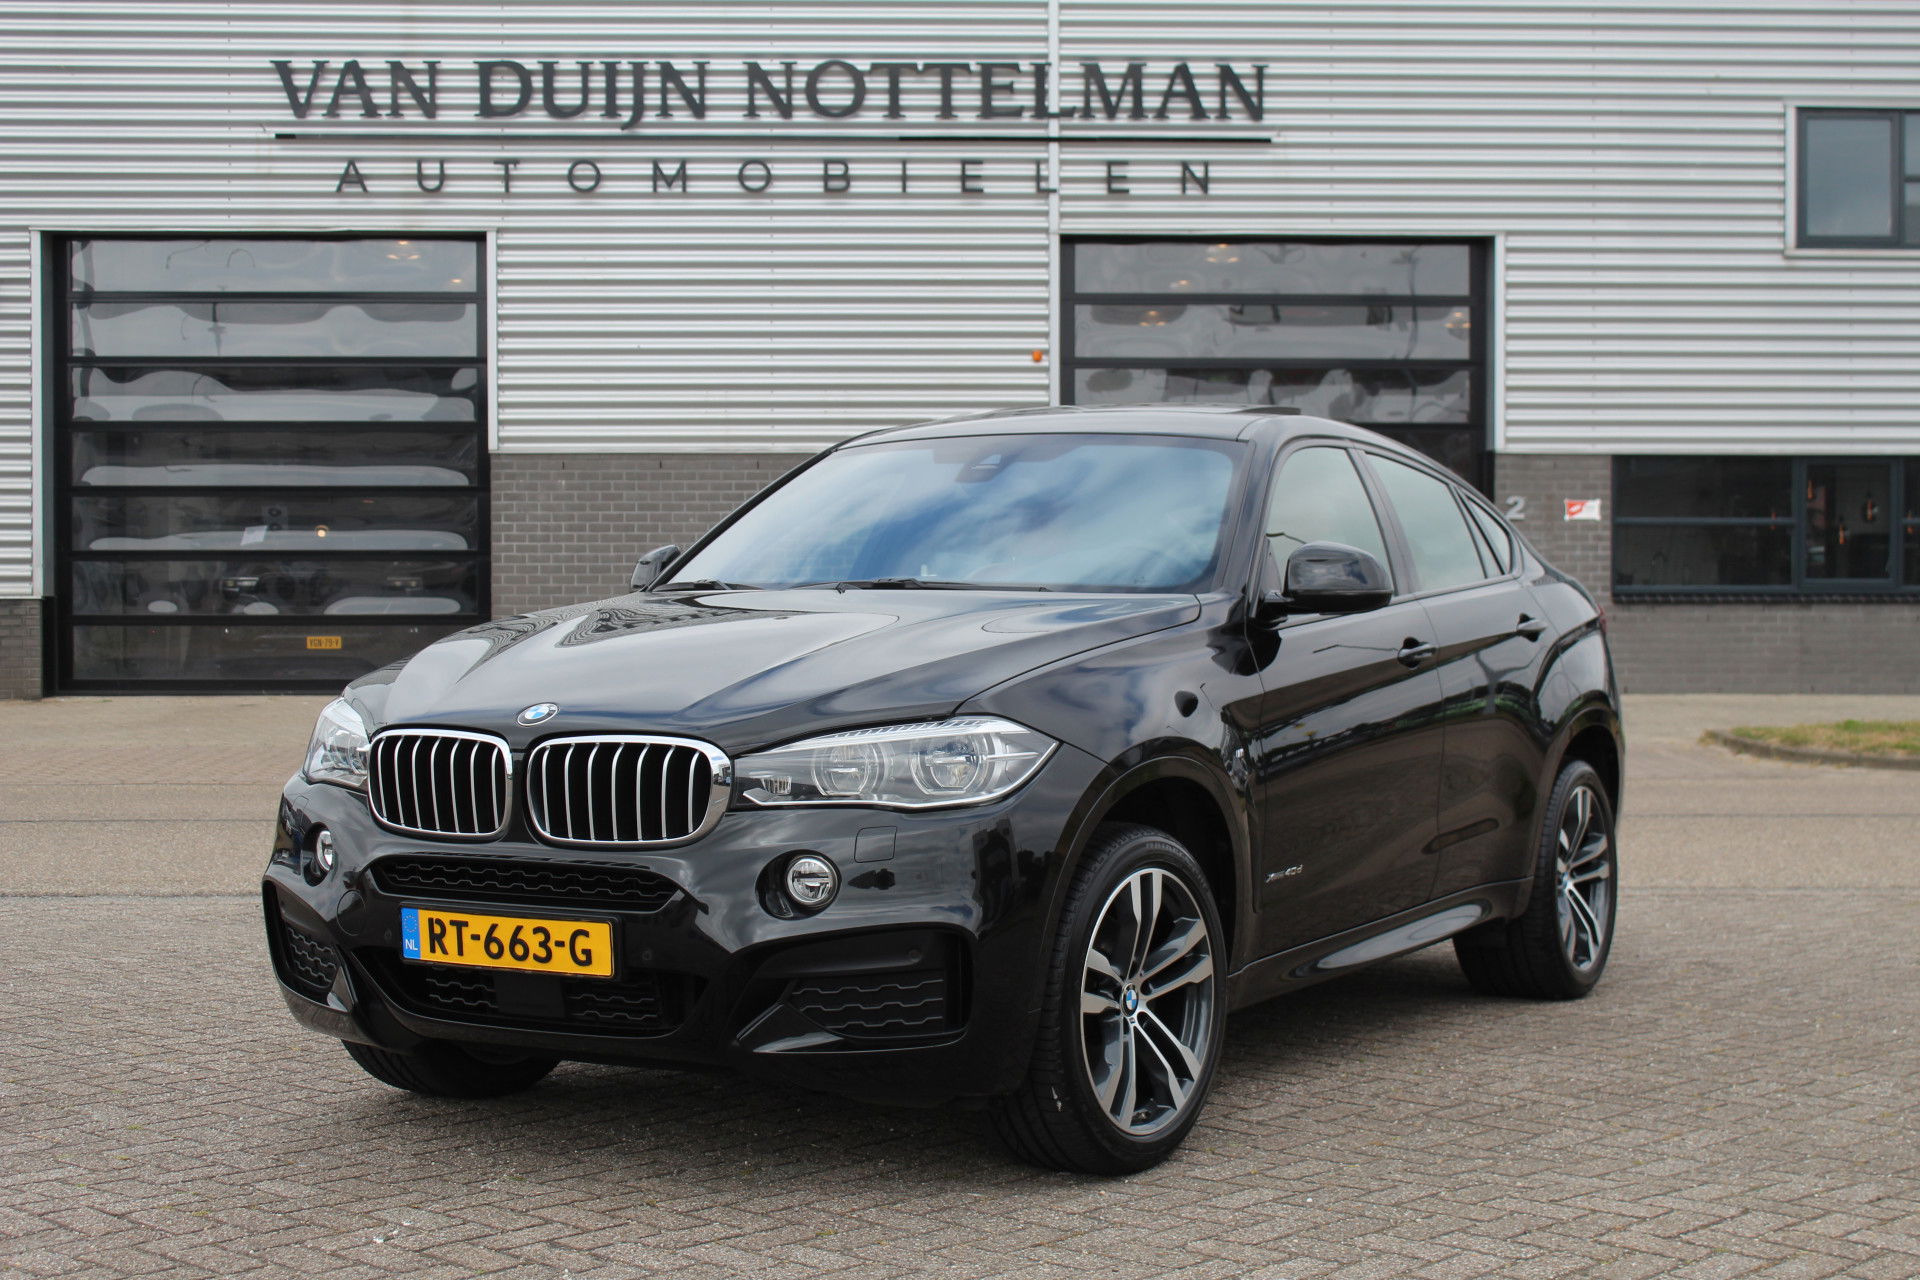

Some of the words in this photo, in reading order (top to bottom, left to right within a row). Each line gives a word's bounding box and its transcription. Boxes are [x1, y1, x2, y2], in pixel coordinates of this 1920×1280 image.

[270, 60, 442, 119] VAN
[473, 60, 710, 131] DUIJN
[742, 59, 1270, 122] NOTTELMAN
[336, 159, 1210, 195] AUTOMOBIELEN
[1505, 496, 1526, 520] 2
[405, 938, 419, 951] NL
[427, 917, 593, 967] RT-663-G
